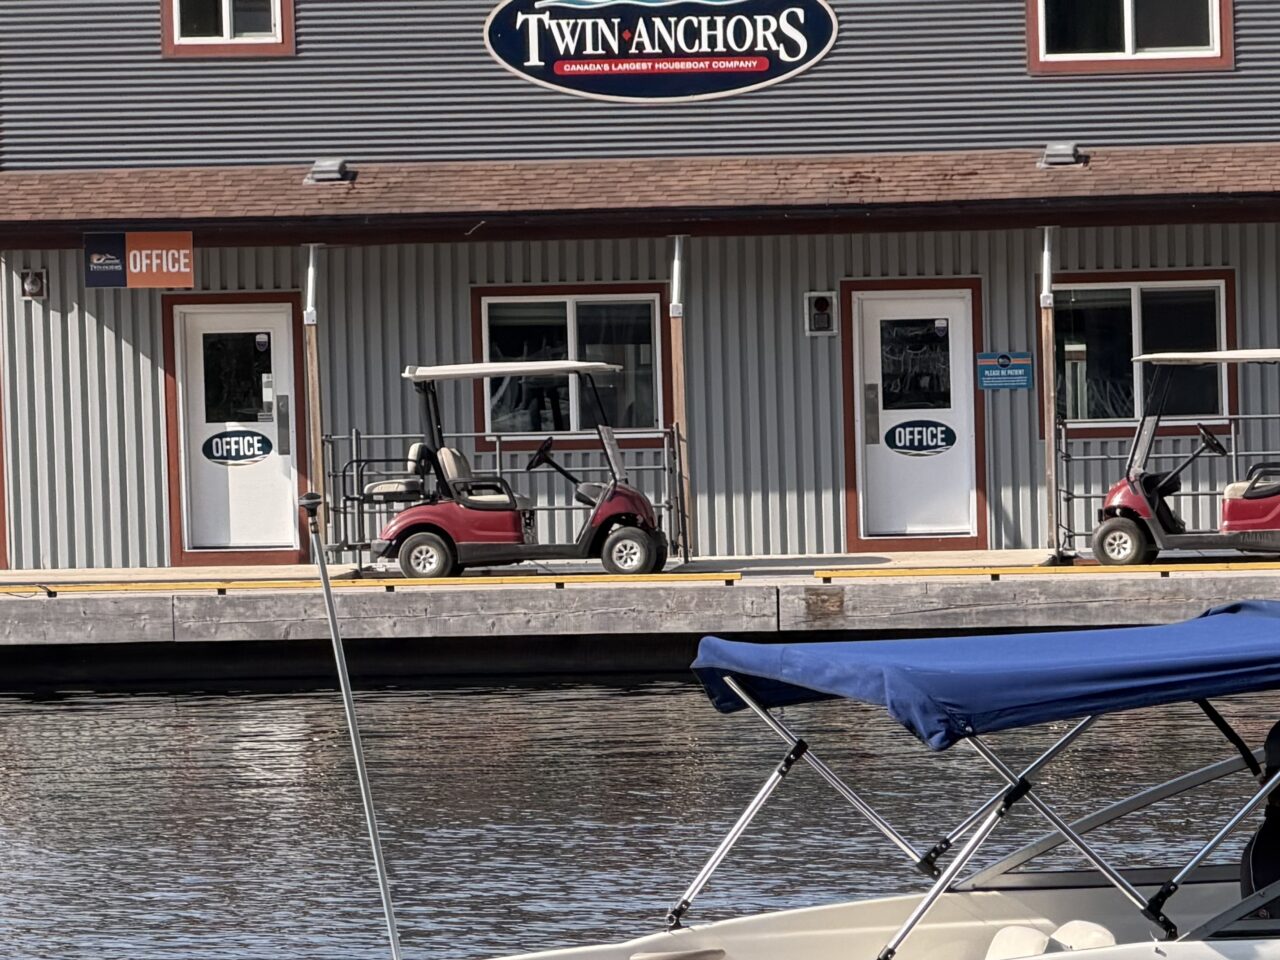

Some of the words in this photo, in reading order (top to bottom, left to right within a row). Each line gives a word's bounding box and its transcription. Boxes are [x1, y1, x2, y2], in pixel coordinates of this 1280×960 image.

[516, 11, 620, 66] TWIN
[629, 8, 807, 62] ANCHORS
[563, 63, 610, 72] CANADA'S
[611, 62, 653, 71] LARGEST
[655, 61, 710, 70] HOUSEBOAT
[712, 60, 758, 69] COMPANY
[129, 249, 191, 273] OFFICE
[212, 435, 263, 457] OFFICE
[895, 426, 946, 447] OFFICE
